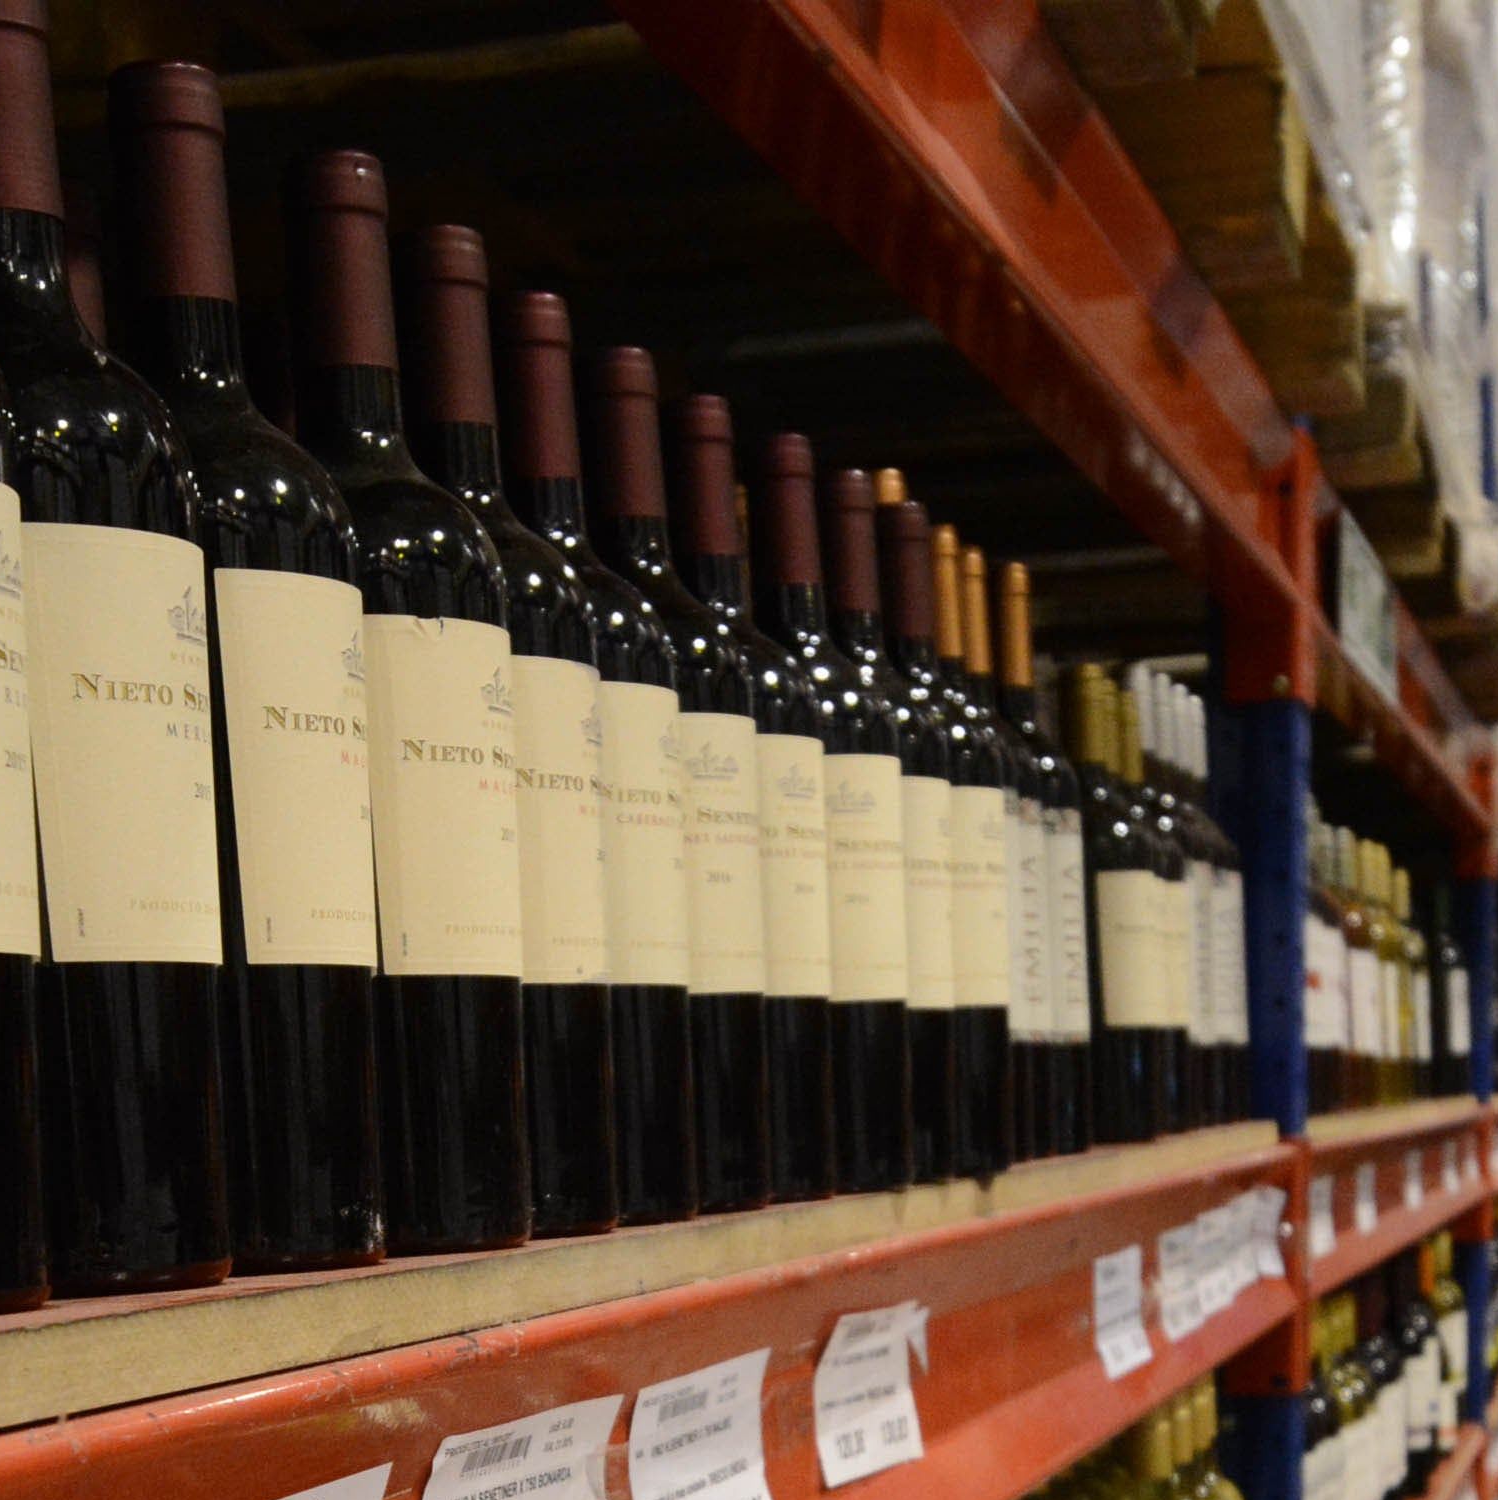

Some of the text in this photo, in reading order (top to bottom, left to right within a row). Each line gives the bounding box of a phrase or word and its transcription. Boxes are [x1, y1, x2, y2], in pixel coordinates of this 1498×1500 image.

[72, 672, 173, 708] NIETO
[263, 705, 345, 736] NIETO
[402, 738, 484, 766] NIETO
[515, 768, 584, 792] NIETO
